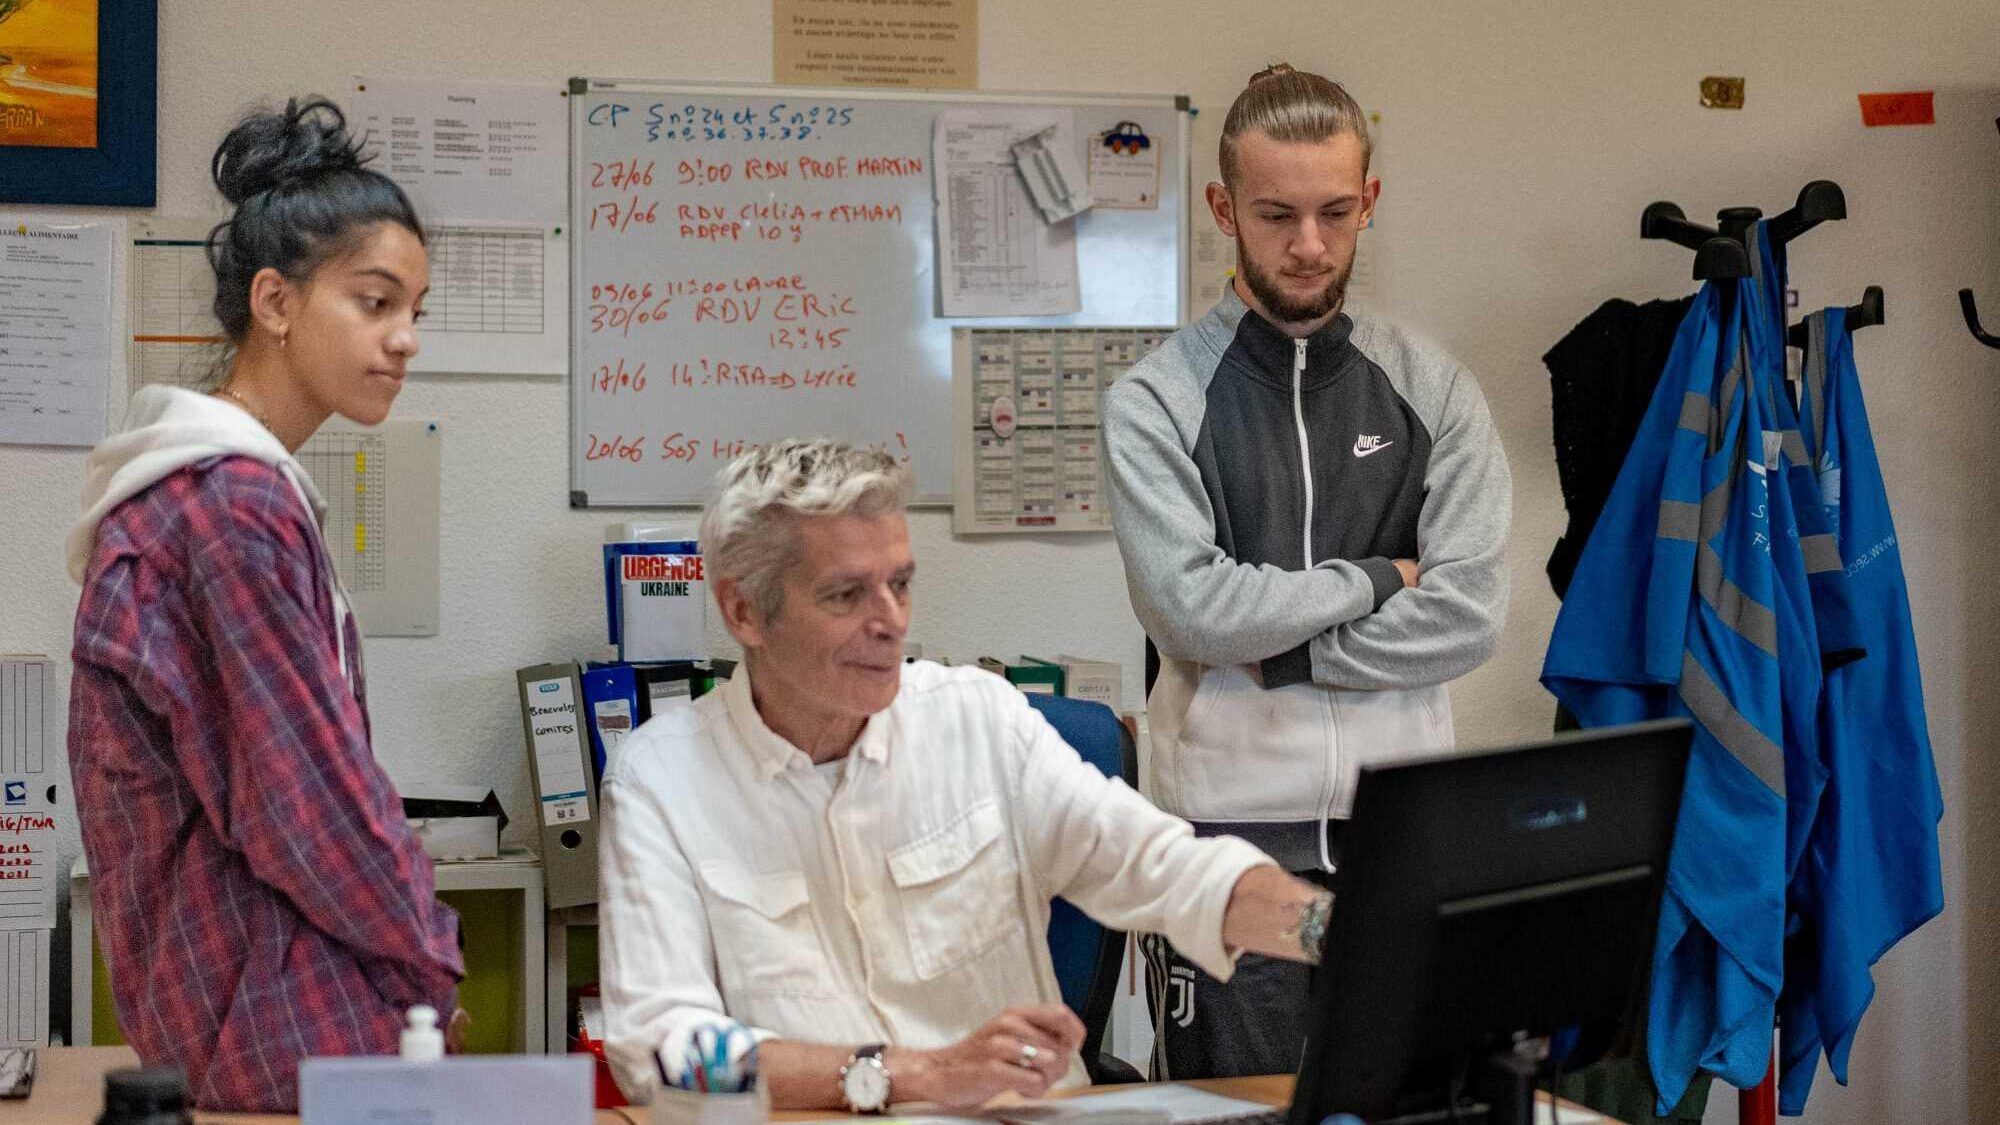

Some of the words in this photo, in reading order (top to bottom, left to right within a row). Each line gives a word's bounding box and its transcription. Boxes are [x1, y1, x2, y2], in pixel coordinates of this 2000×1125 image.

[592, 159, 655, 190] 27/06
[745, 158, 789, 180] RDV
[591, 196, 660, 233] 17/06
[678, 204, 726, 220] RDV
[695, 295, 761, 323] RDV
[1357, 434, 1382, 450] NIKE
[623, 555, 704, 581] URGENCE
[641, 581, 689, 597] UKRAINE
